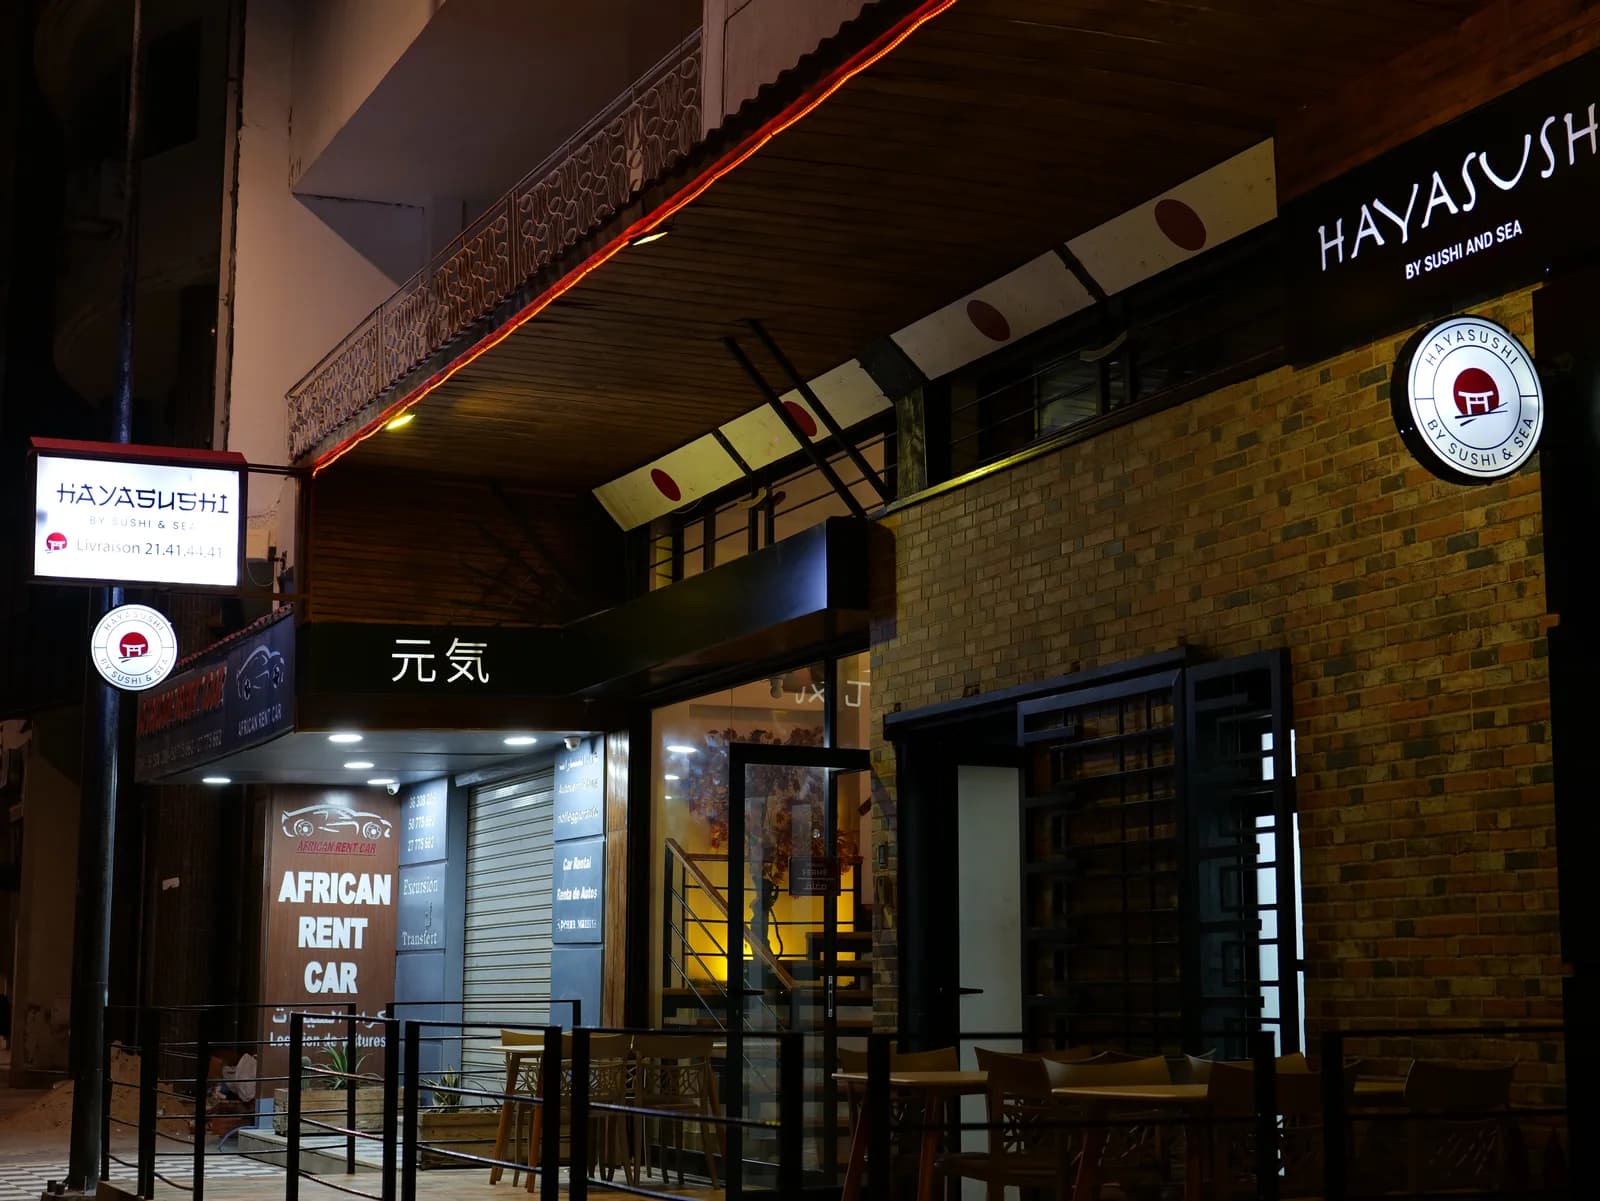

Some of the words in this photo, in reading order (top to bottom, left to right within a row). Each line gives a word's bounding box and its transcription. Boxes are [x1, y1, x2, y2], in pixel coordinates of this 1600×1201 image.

[1405, 260, 1423, 280] BY
[1424, 242, 1463, 272] SUSHI
[1465, 231, 1494, 257] AND
[1495, 219, 1523, 244] SEA
[1425, 328, 1519, 367] HAYASUSHI
[1427, 418, 1446, 441] BY
[1448, 442, 1497, 467] SUSHI
[1502, 447, 1513, 461] &
[1513, 417, 1535, 449] SEA
[56, 482, 229, 514] HAYASUSHI
[88, 514, 105, 526] BY
[157, 519, 166, 530] &
[76, 536, 141, 556] Livraison
[391, 637, 490, 684] 元気
[111, 670, 142, 686] SUSHI
[238, 715, 258, 737] AFRICAN
[258, 708, 271, 728] RENT
[271, 703, 282, 723] CAR
[296, 840, 334, 852] AFRICAN
[335, 842, 358, 853] RENT
[359, 843, 377, 854] CAR
[563, 857, 573, 871] Car
[278, 871, 392, 906] AFRICAN
[403, 874, 438, 896] Excursion
[298, 916, 368, 949] RENT
[402, 929, 437, 946] Transfert
[304, 961, 358, 994] CAR
[323, 1032, 338, 1047] de
[341, 1033, 387, 1048] vitures
